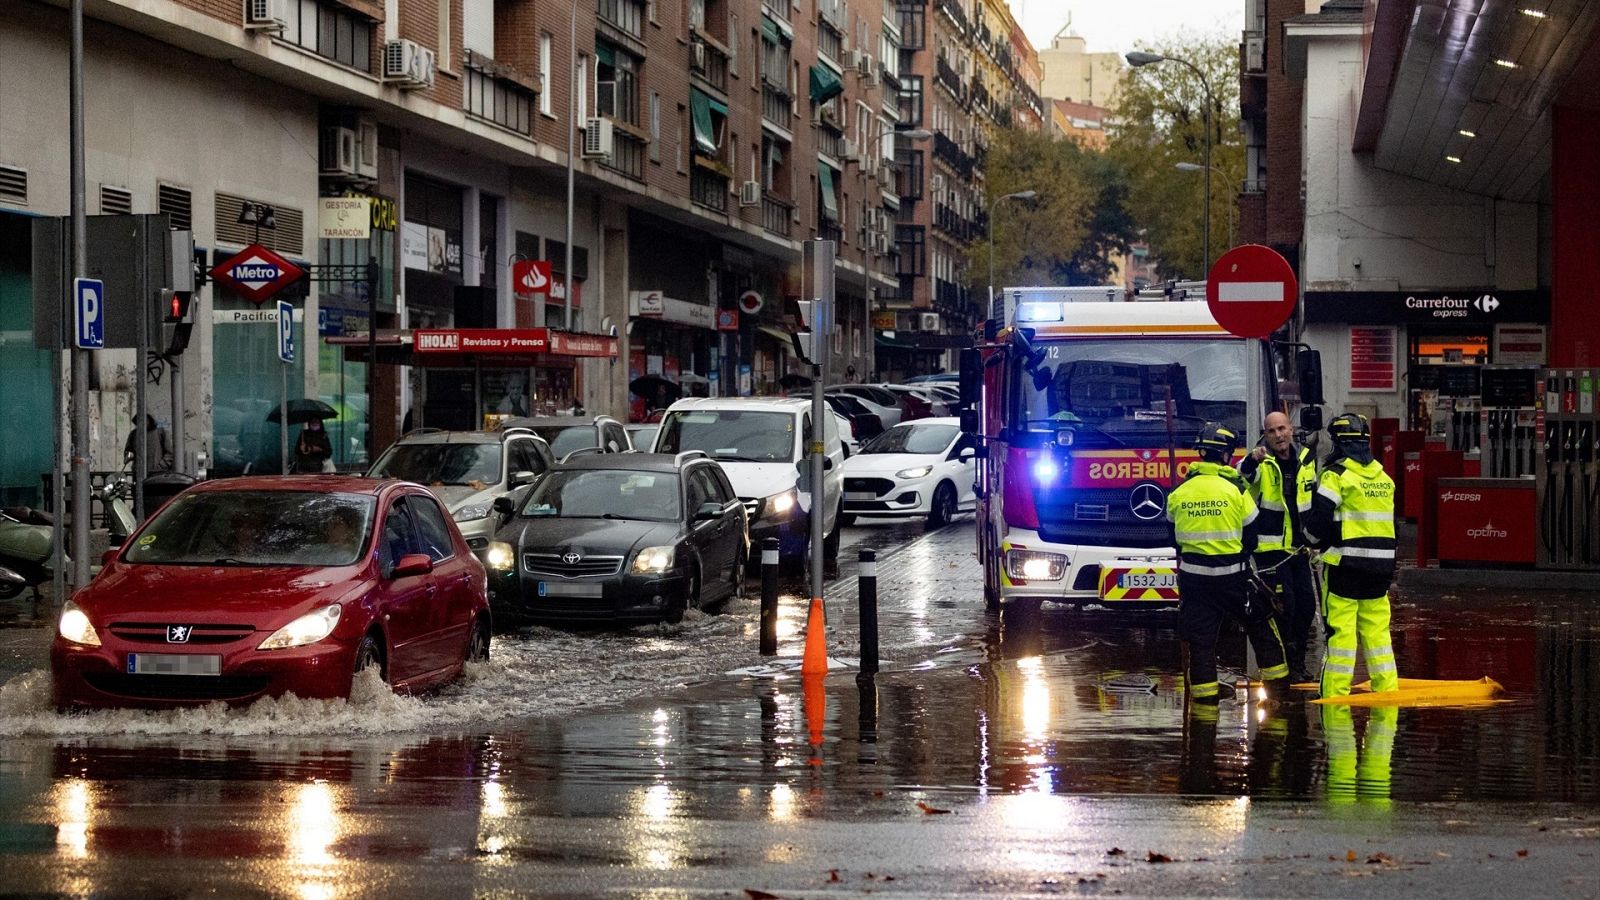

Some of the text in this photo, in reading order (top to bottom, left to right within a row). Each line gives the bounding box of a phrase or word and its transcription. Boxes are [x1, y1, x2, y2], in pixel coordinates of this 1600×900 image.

[236, 266, 276, 279] Metro
[1406, 297, 1469, 309] Carrefour
[83, 288, 99, 340] P
[1433, 310, 1467, 318] express
[282, 310, 292, 353] P
[420, 334, 458, 348] ¡HOLA!
[463, 338, 502, 346] Revistas
[511, 338, 544, 346] Prensa
[1454, 493, 1481, 501] CEPSA
[1181, 500, 1229, 509] BOMBEROS
[1187, 509, 1222, 517] MADRID
[1467, 526, 1507, 539] optima
[1127, 575, 1178, 586] 1532 JJ
